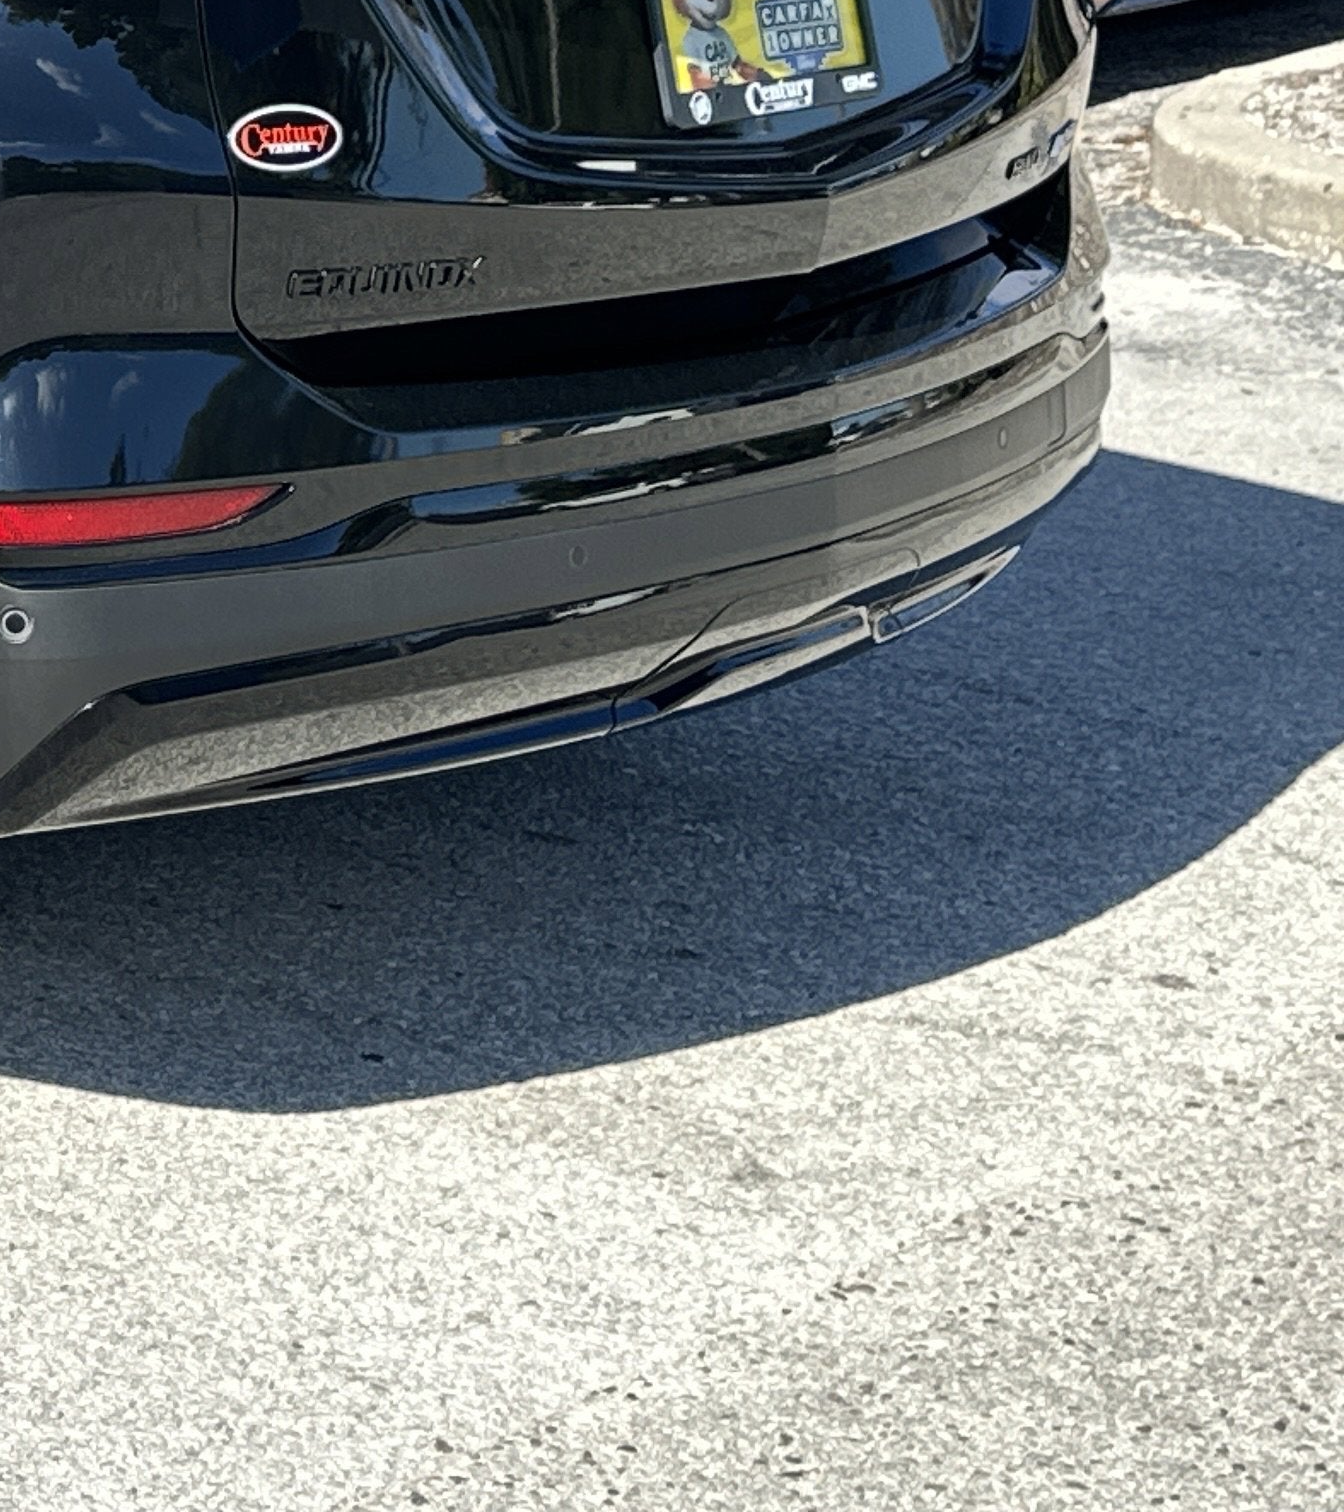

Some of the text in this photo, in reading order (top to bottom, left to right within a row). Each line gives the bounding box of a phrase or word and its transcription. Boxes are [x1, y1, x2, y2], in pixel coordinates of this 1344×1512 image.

[760, 0, 838, 26] CARFAX
[745, 77, 813, 115] Century
[240, 122, 330, 158] Century
[286, 255, 487, 299] EQUINOX
